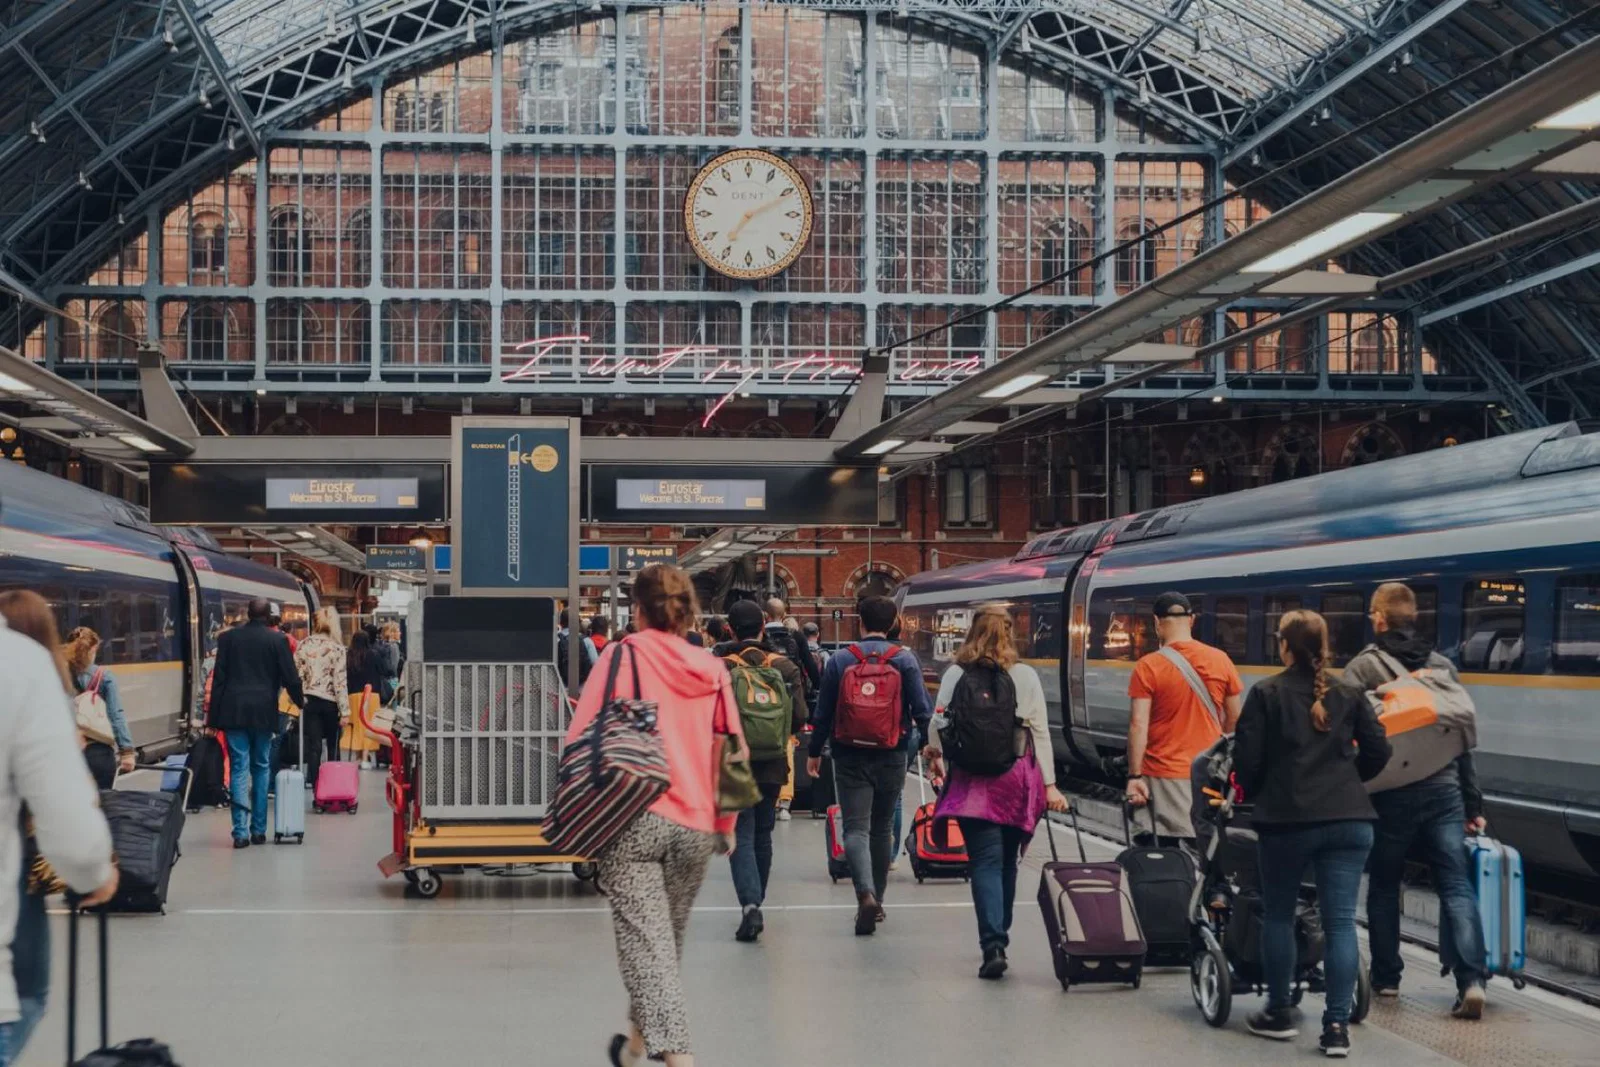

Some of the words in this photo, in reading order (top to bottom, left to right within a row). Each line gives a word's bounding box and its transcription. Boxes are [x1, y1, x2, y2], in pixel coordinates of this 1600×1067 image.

[731, 191, 764, 200] DENT
[501, 335, 590, 381] I
[310, 480, 356, 493] Eurostar
[659, 481, 703, 494] Eurostar
[289, 493, 323, 503] Welcome
[324, 494, 333, 503] to
[346, 493, 377, 503] Pancras
[639, 493, 672, 504] Welcome
[674, 494, 682, 504] to
[695, 494, 724, 504] Pancras
[380, 548, 393, 556] Way
[636, 548, 651, 557] Way
[652, 548, 663, 556] out
